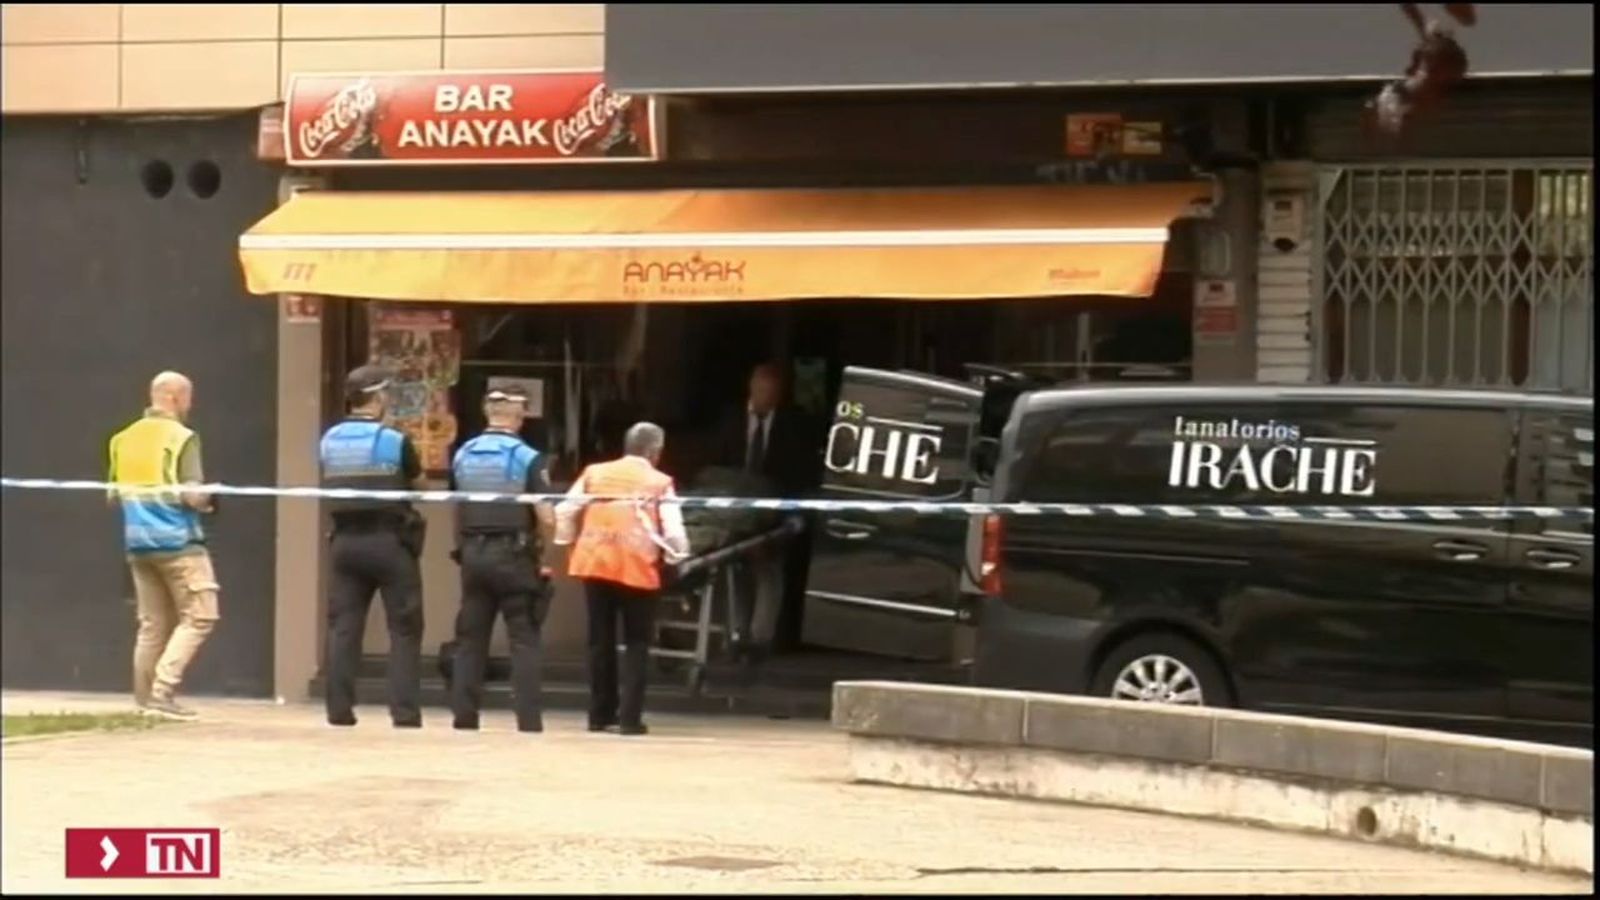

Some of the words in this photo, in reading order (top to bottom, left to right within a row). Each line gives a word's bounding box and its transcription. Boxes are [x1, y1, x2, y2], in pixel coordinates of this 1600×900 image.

[434, 84, 514, 112] BAR
[397, 118, 550, 149] ANAYAK
[1174, 415, 1301, 440] tanatorios
[824, 422, 942, 486] CHE
[1167, 440, 1377, 497] IRACHE
